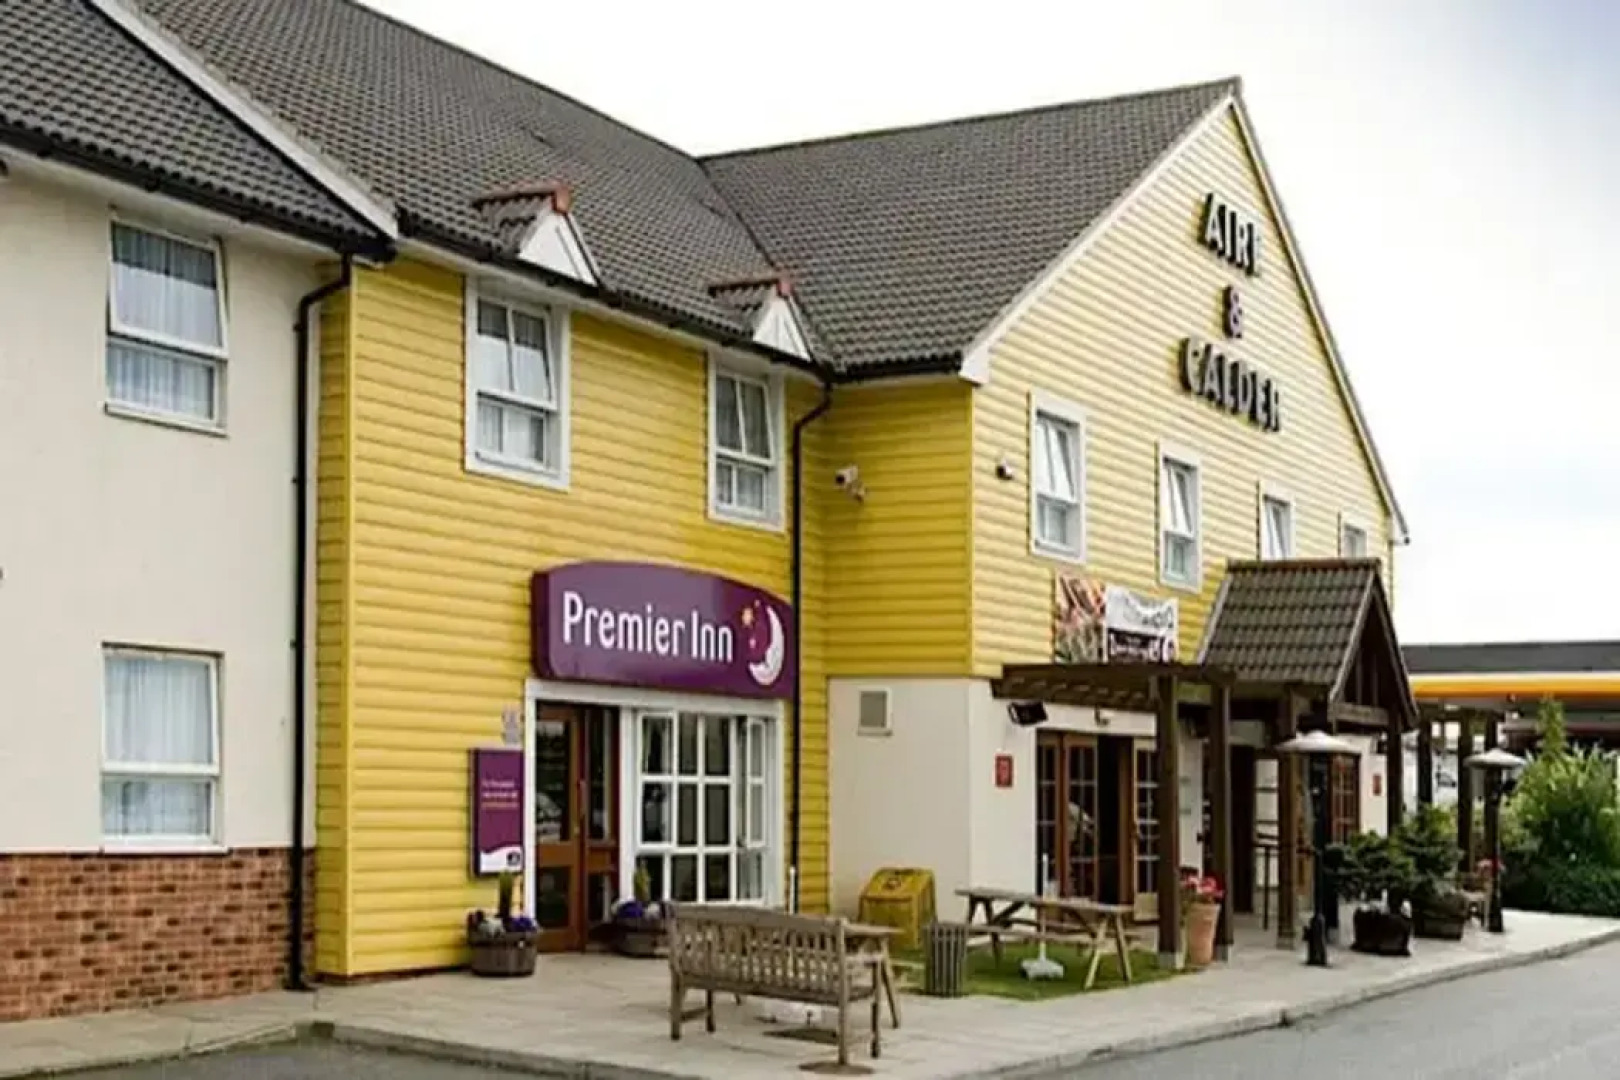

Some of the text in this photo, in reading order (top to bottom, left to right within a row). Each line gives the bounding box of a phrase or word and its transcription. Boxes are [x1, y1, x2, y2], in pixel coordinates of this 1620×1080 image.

[1222, 285, 1243, 338] &
[562, 590, 733, 663] Premier Inn
